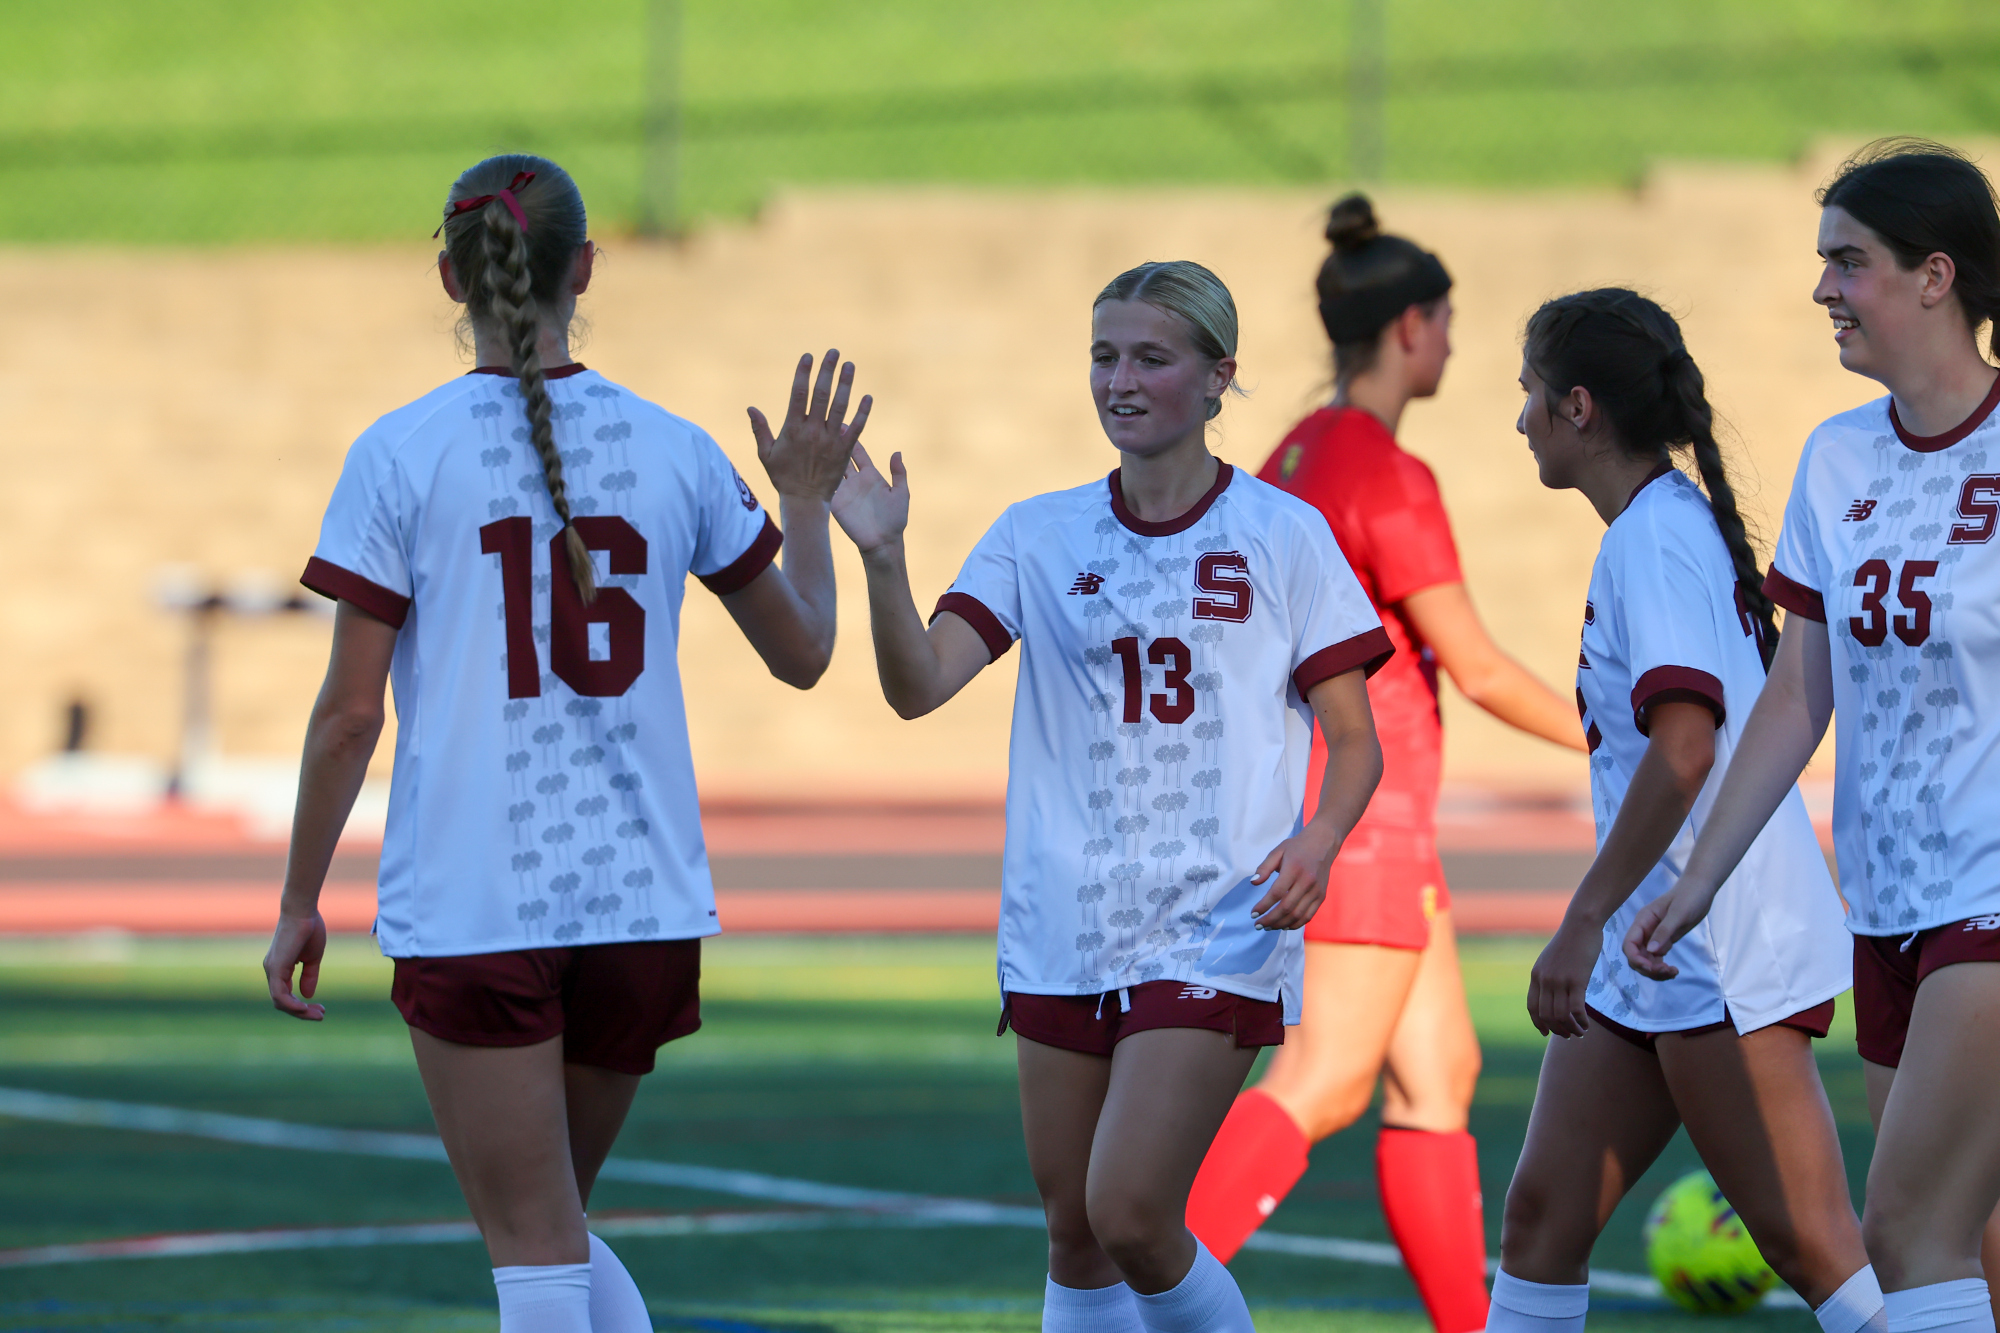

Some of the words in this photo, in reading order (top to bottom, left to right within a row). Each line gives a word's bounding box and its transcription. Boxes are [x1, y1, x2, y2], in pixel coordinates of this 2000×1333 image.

[1946, 473, 2000, 545] S
[480, 516, 648, 699] 16
[1192, 550, 1254, 624] S
[1849, 559, 1939, 647] 35
[1111, 636, 1195, 724] 13
